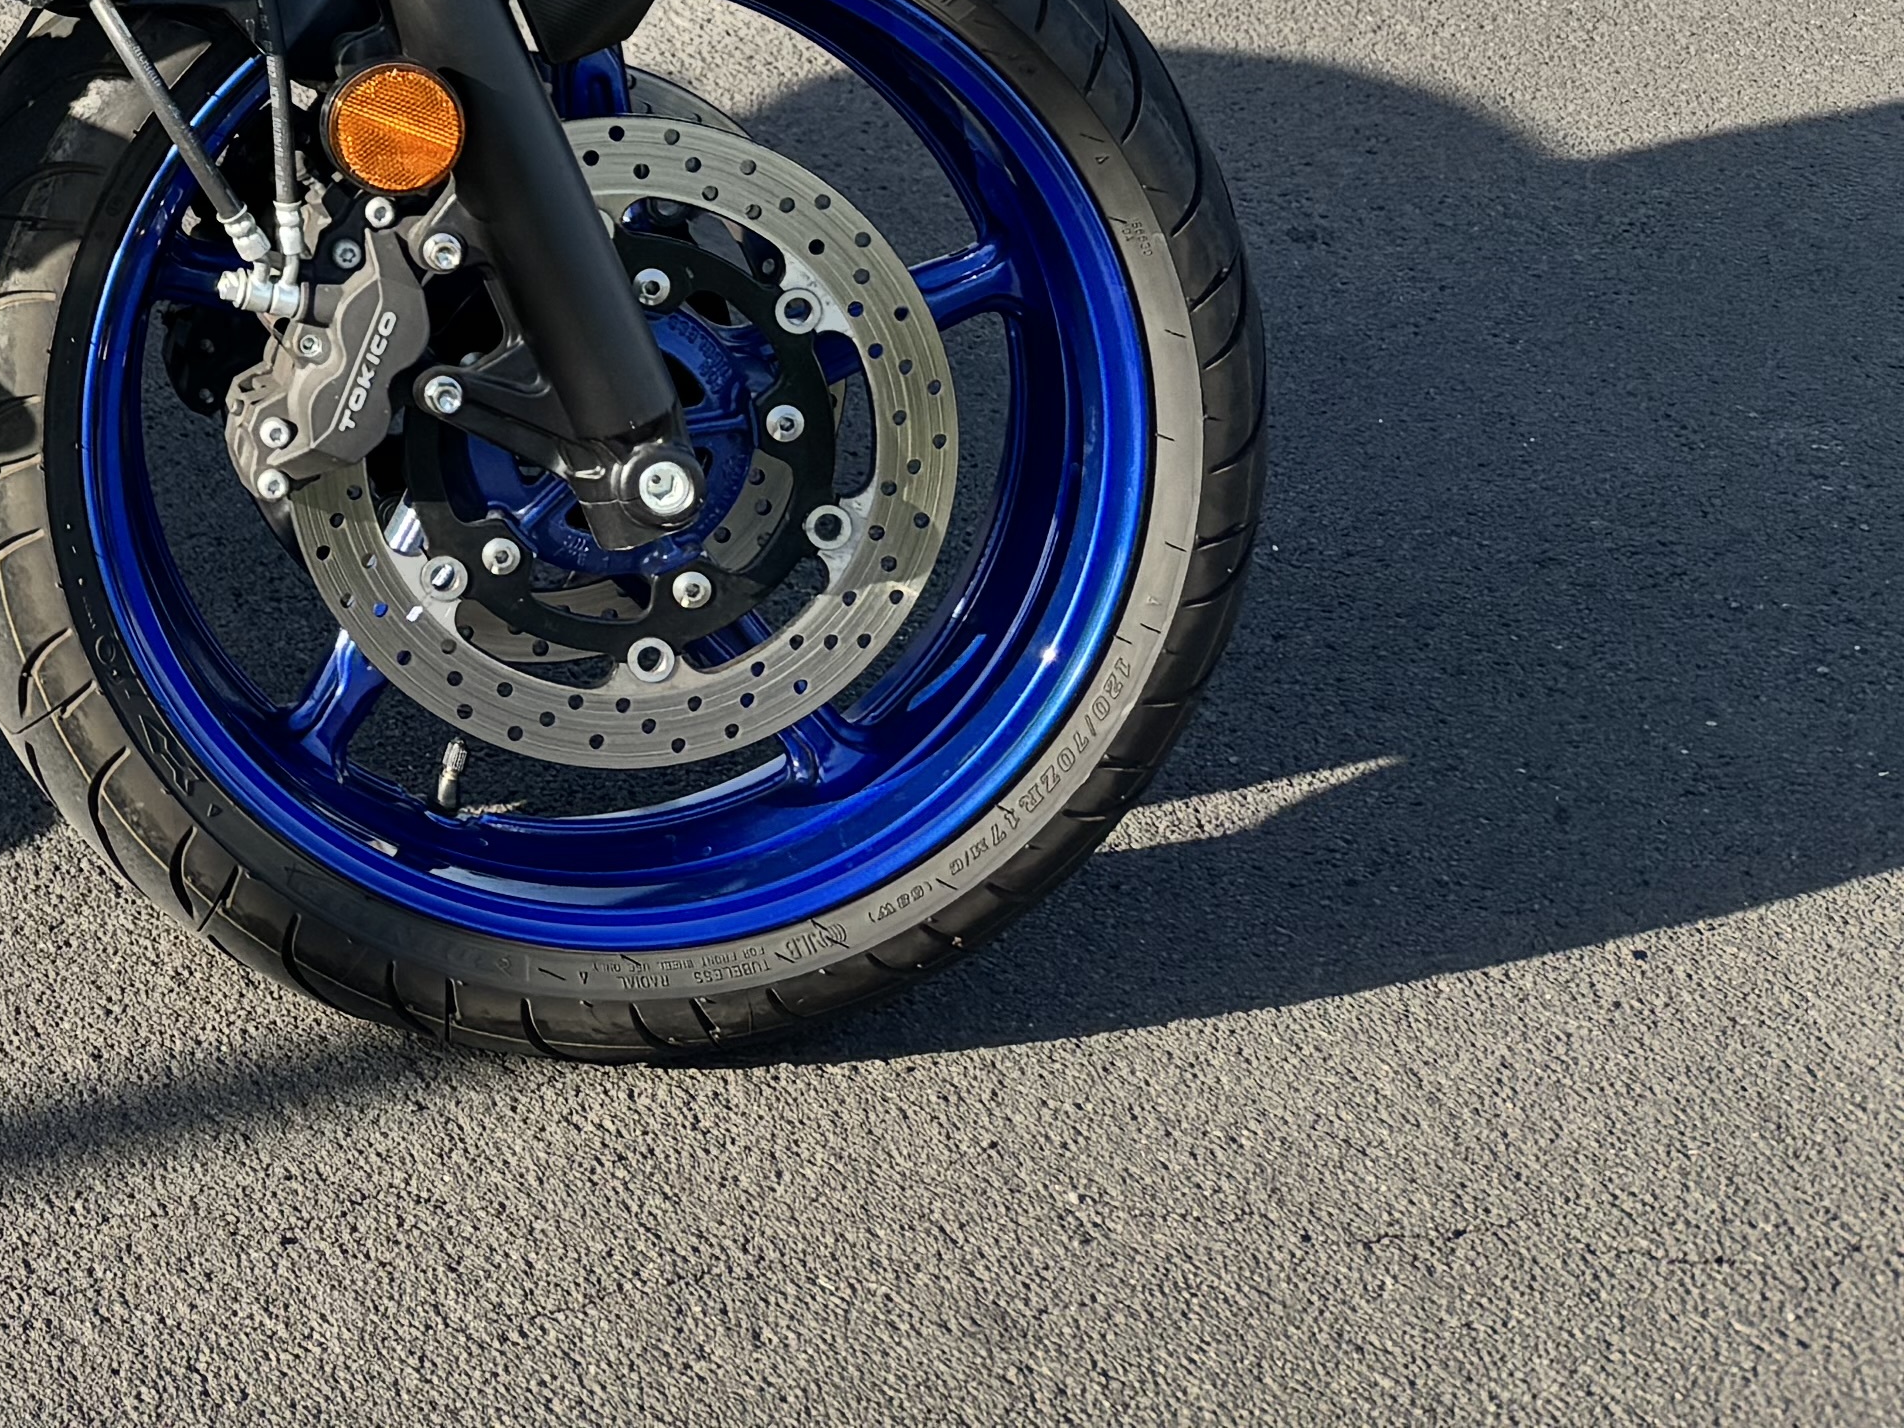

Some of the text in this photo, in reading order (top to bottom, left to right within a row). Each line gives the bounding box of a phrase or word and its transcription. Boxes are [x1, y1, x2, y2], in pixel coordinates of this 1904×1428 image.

[339, 310, 398, 431] TOKICO
[616, 957, 771, 989] TUBELESS RADIAL
